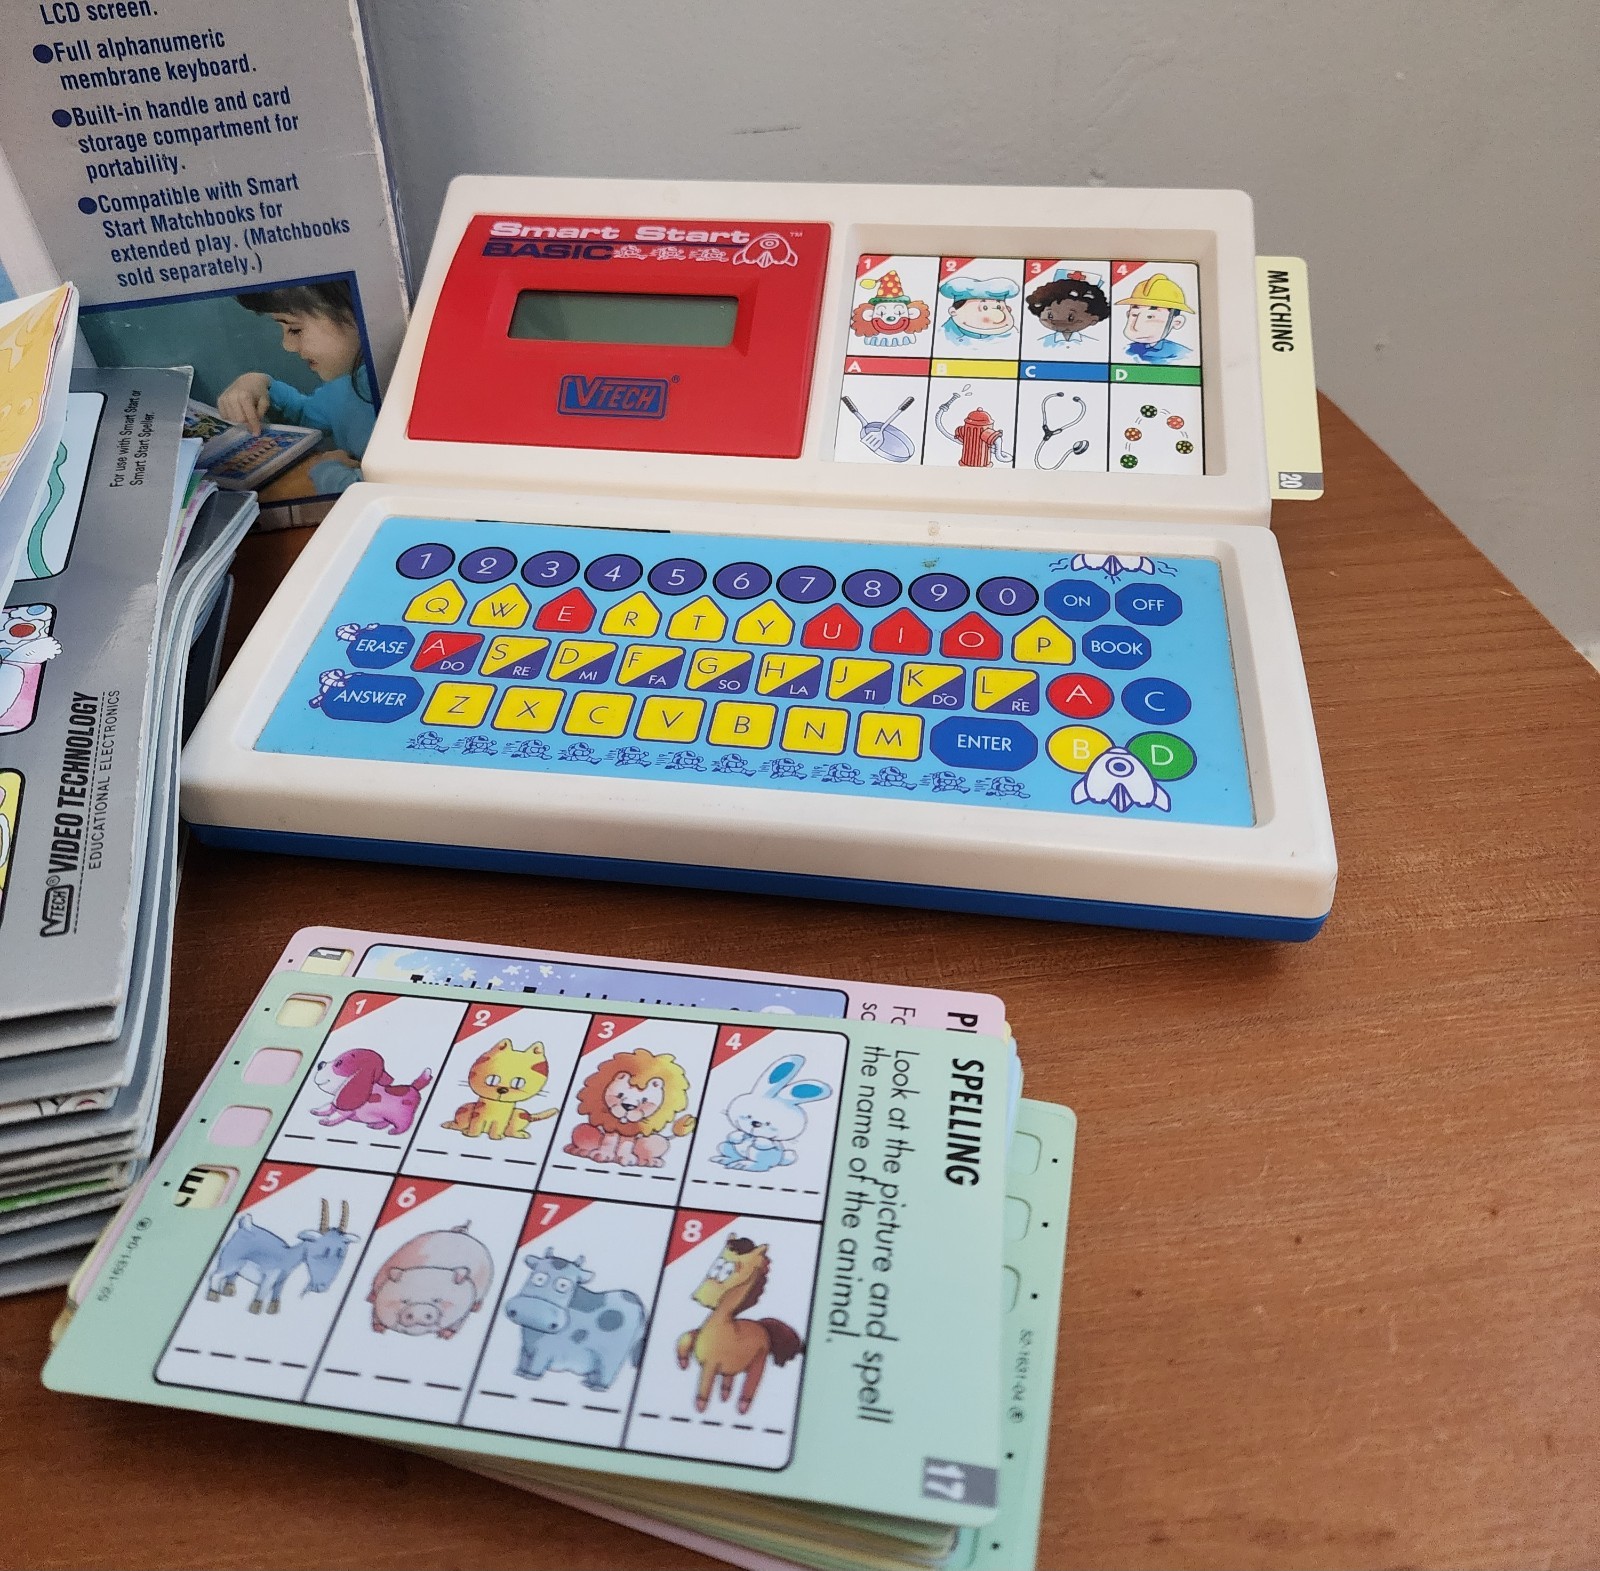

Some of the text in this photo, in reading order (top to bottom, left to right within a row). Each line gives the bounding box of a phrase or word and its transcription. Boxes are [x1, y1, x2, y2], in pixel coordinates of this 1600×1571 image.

[39, 0, 158, 26] LCD screen.
[53, 29, 226, 62] Full alphanumeric
[60, 53, 257, 91] membrane keyboard.
[72, 86, 291, 127] Built-in handle and card
[77, 113, 300, 155] storage compartment for
[86, 153, 186, 183] portability.
[98, 172, 300, 216] Compatible with Smart
[103, 202, 283, 239] Start Matchbooks for
[111, 216, 351, 263] extended play. (Matchbooks
[489, 222, 621, 240] Smart
[634, 226, 750, 245] Start
[481, 241, 614, 261] BASIC
[117, 252, 264, 289] sold separately.)
[863, 258, 872, 270] 1
[945, 261, 957, 272] 2
[1030, 262, 1042, 274] 3
[1116, 264, 1129, 276] 4
[1267, 270, 1294, 353] MATCHING
[847, 362, 862, 374] A
[936, 364, 948, 376] B
[1024, 365, 1036, 378] C
[1115, 368, 1128, 381] D
[110, 390, 142, 487] For use with Smart Start or
[130, 412, 155, 486] Smart Start Speller.
[1279, 472, 1303, 489] 20
[418, 553, 430, 570] 1
[476, 557, 496, 574] 2
[540, 561, 560, 578] 3
[604, 564, 622, 582] 4
[667, 569, 686, 586] 5
[733, 572, 750, 589] 6
[799, 577, 816, 593] 7
[863, 580, 881, 597] 8
[930, 584, 948, 601] 9
[999, 588, 1016, 606] 0
[1063, 594, 1091, 607] ON
[1132, 599, 1165, 611] OFF
[425, 598, 446, 615] Q
[490, 602, 517, 618] W
[558, 606, 573, 622] E
[624, 612, 638, 626] R
[692, 615, 706, 631] T
[757, 619, 774, 635] Y
[823, 622, 841, 639] U
[356, 639, 407, 655] ERASE
[423, 638, 446, 656] A
[959, 631, 984, 648] O
[1037, 637, 1051, 652] P
[1090, 640, 1143, 655] BOOK
[491, 643, 510, 660] S
[560, 647, 579, 664] D
[628, 651, 643, 668] F
[440, 660, 464, 672] DO
[512, 665, 529, 677] RE
[697, 657, 718, 673] G
[764, 661, 785, 678] H
[579, 670, 597, 681] MI
[648, 674, 666, 686] FA
[836, 666, 848, 683] J
[907, 669, 923, 687] K
[718, 679, 740, 690] SO
[789, 684, 808, 695] LA
[982, 676, 993, 694] L
[334, 690, 407, 707] ANSWER
[864, 690, 876, 700] TI
[1066, 684, 1092, 704] A
[1144, 691, 1165, 712] C
[448, 695, 471, 714] Z
[516, 700, 540, 719] X
[589, 706, 609, 724] C
[661, 710, 684, 728] V
[733, 716, 750, 734] B
[804, 721, 826, 740] N
[875, 728, 902, 747] M
[957, 734, 1012, 751] ENTER
[57, 691, 99, 809] TECHNOLOGY
[1073, 739, 1091, 759] B
[1151, 744, 1173, 766] D
[89, 690, 120, 870] EDUCATIONAL ELECTRONICS
[48, 813, 84, 874] VIDEO
[353, 1000, 368, 1015] 1
[473, 1011, 490, 1027] 2
[597, 1022, 614, 1038] 3
[725, 1033, 742, 1050] 4
[861, 1046, 891, 1077] the
[891, 1049, 920, 1099] Look
[852, 1086, 875, 1149] name
[889, 1107, 910, 1130] at
[944, 1058, 984, 1187] SPELLING
[884, 1139, 915, 1174] the
[848, 1157, 876, 1183] of
[260, 1171, 282, 1192] 5
[397, 1190, 415, 1207] 6
[540, 1204, 556, 1224] 7
[841, 1191, 875, 1228] the
[682, 1221, 700, 1241] 8
[872, 1178, 907, 1273] picture
[826, 1238, 862, 1342] animal.
[865, 1283, 899, 1341] and
[853, 1351, 893, 1423] spell
[925, 1464, 965, 1500] 17
